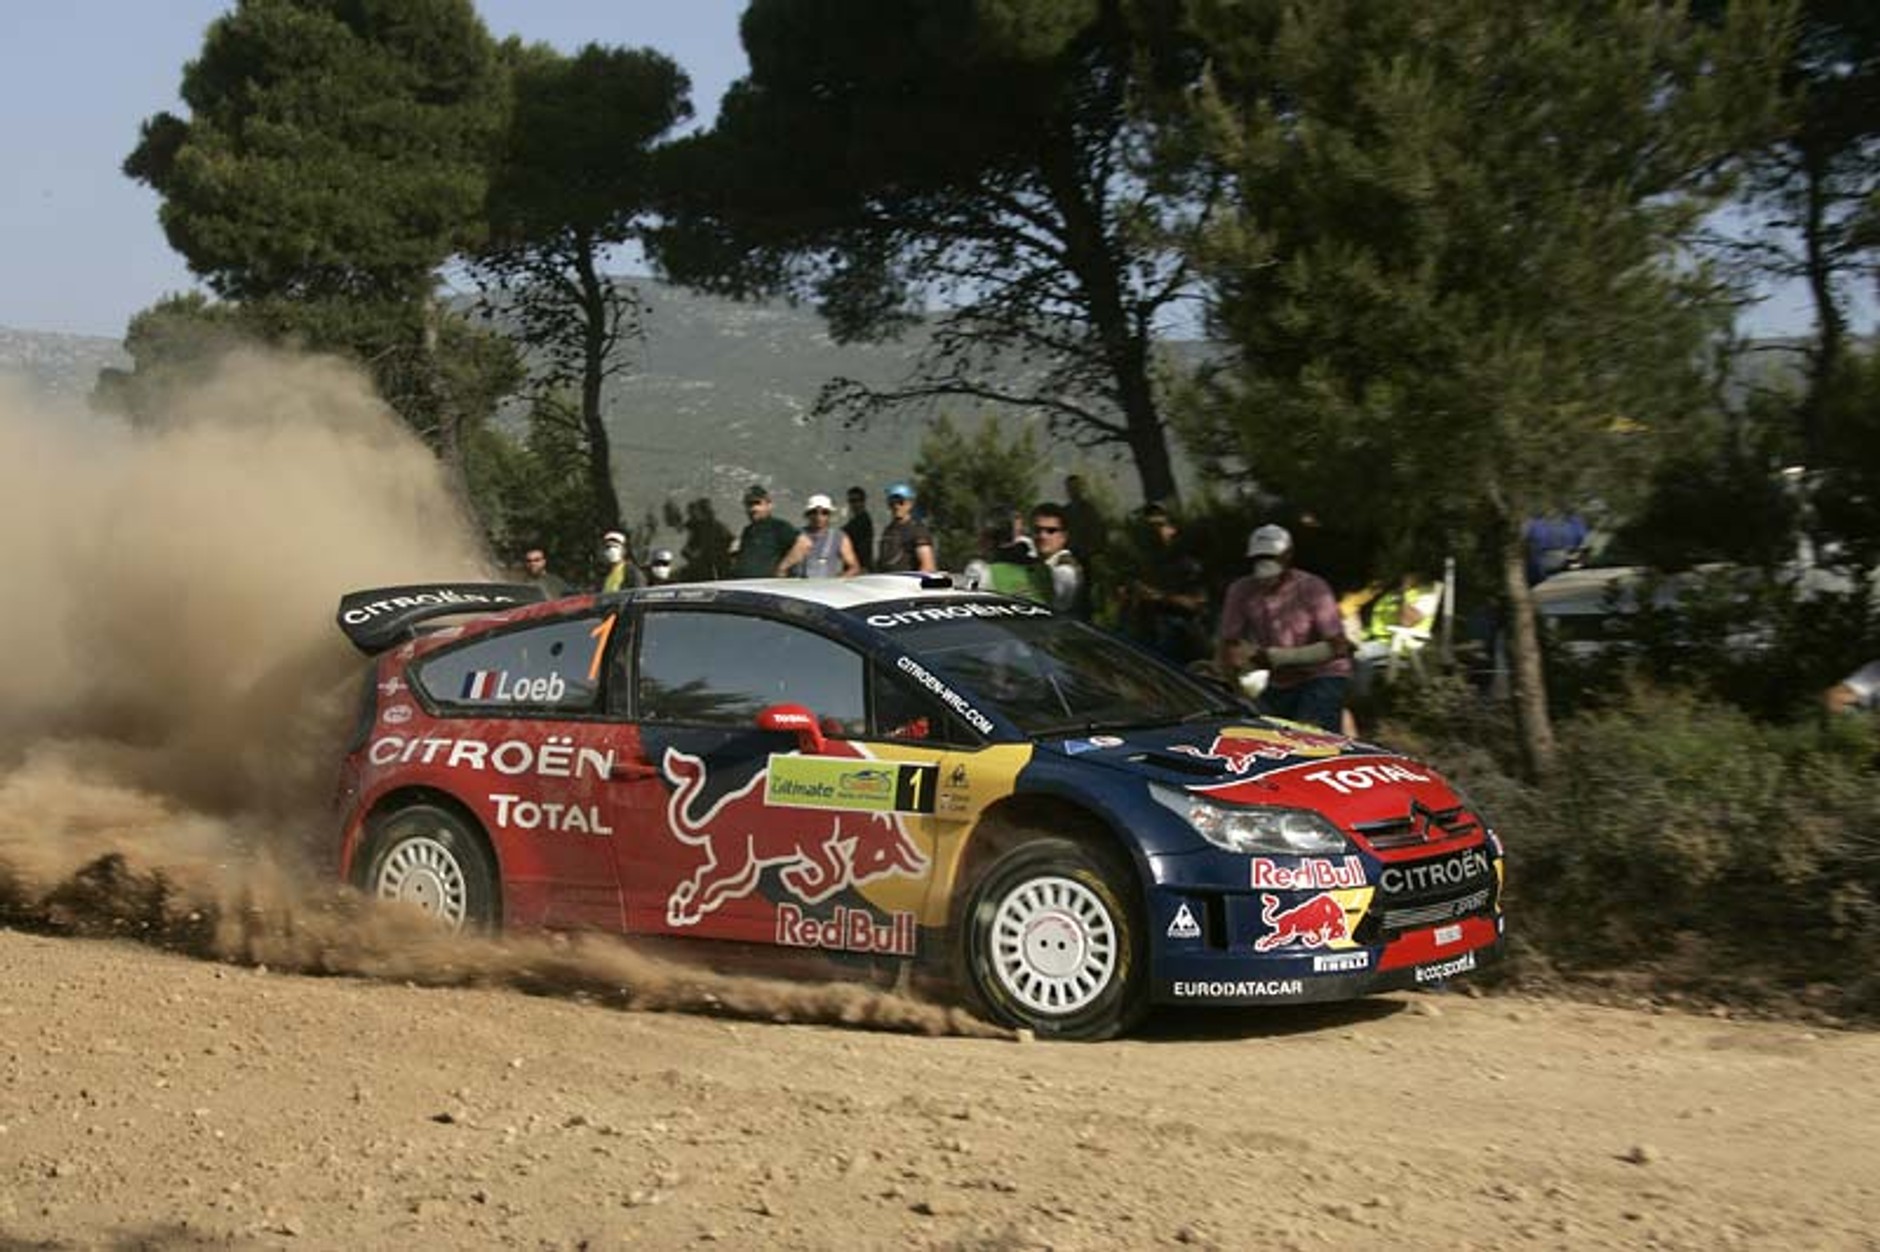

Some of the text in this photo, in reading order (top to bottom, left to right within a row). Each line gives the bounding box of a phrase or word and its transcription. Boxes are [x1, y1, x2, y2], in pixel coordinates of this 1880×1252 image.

[588, 613, 617, 680] 1
[497, 671, 565, 700] Loeb
[368, 736, 615, 780] CITROËN
[1303, 763, 1430, 794] TOTAL
[909, 768, 922, 809] 1
[1251, 855, 1367, 891] Red Bull
[1380, 849, 1489, 894] CITROËN
[776, 902, 917, 955] Red Bull
[1174, 980, 1303, 997] EURODATACAR
